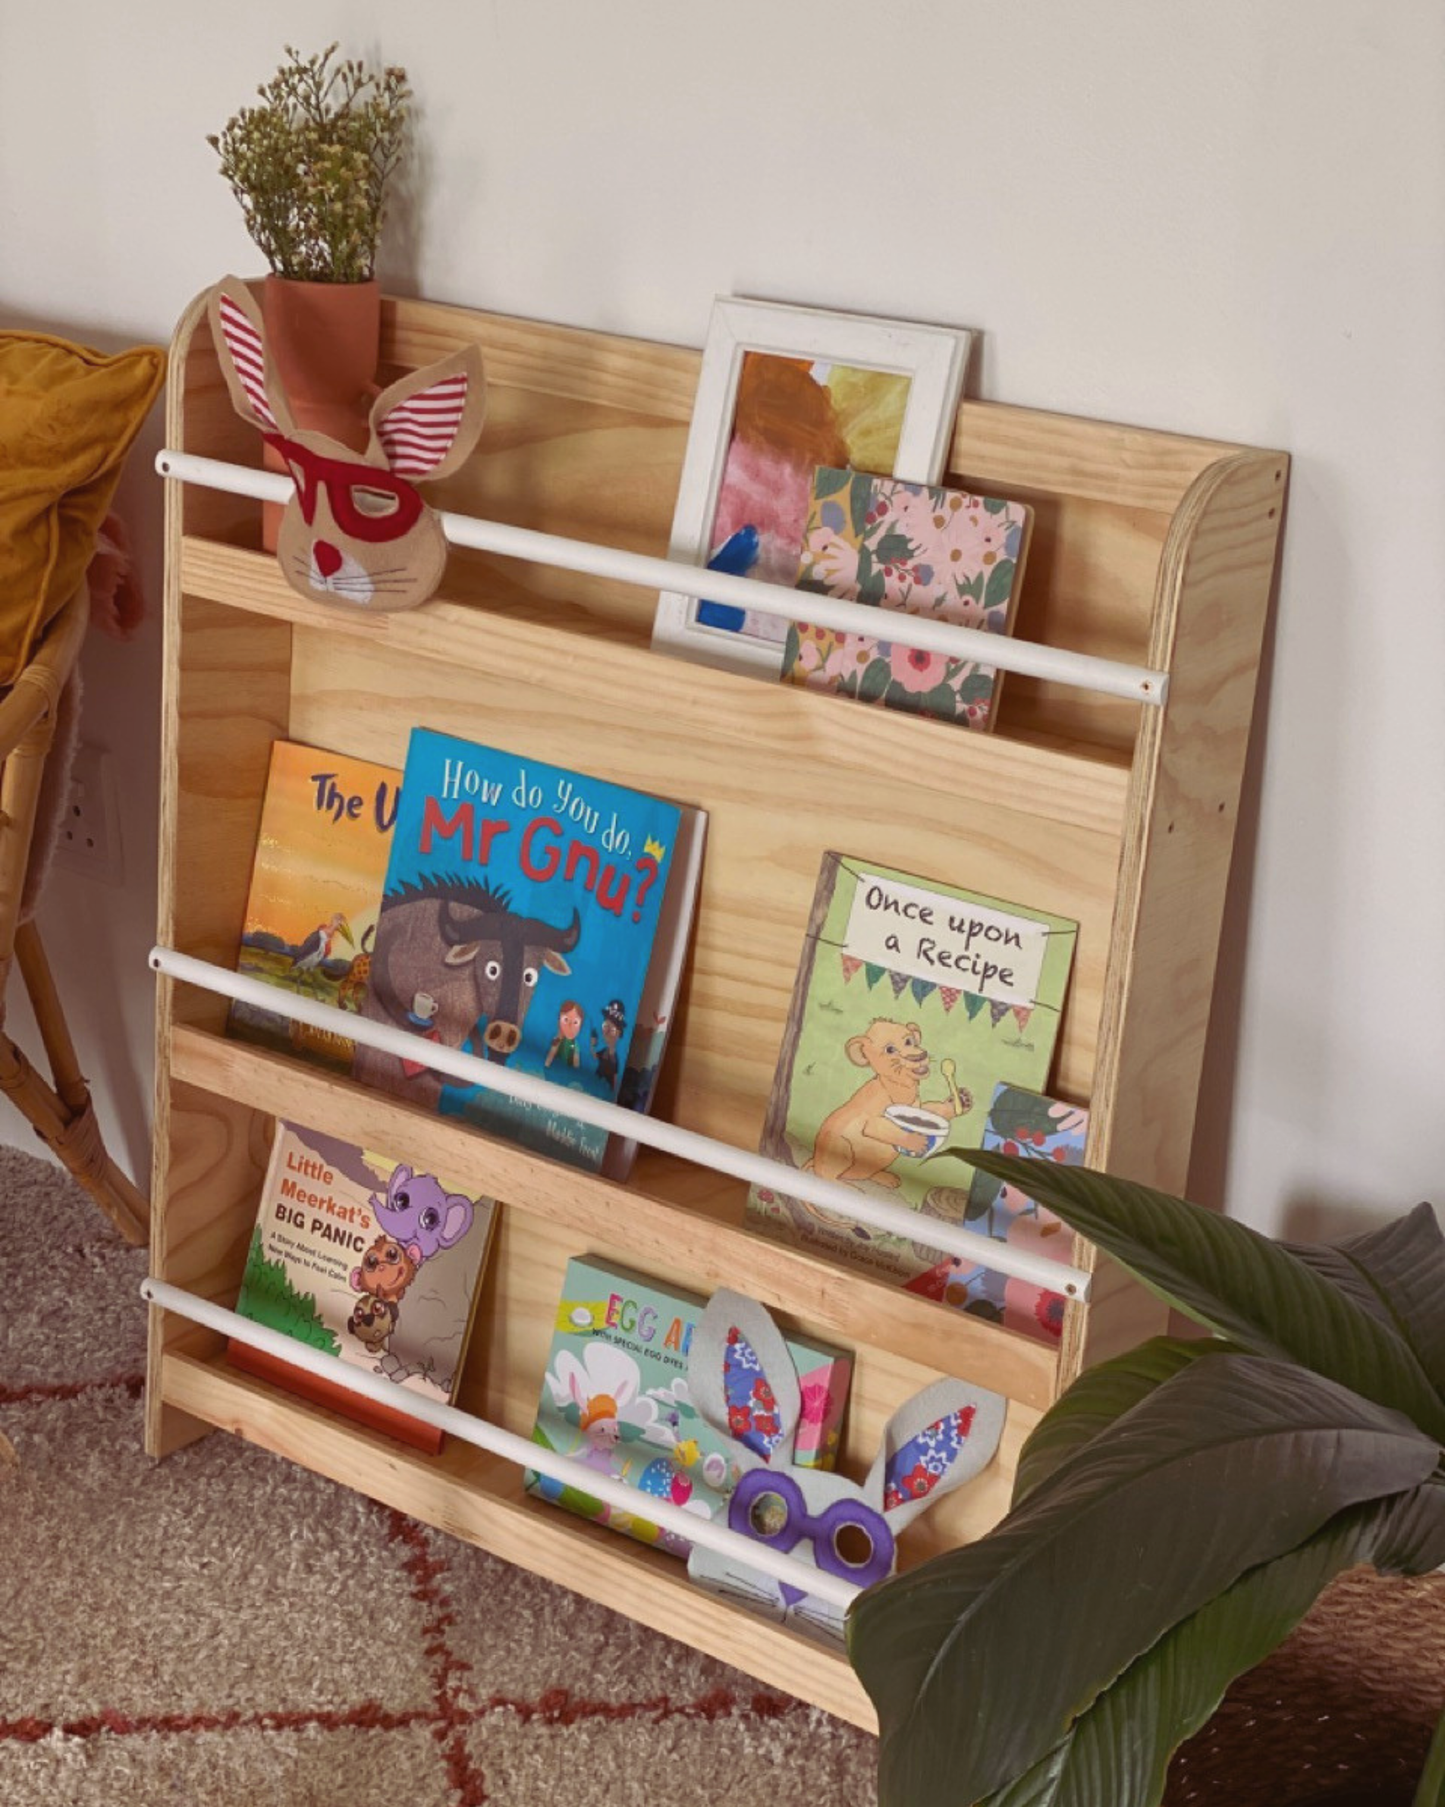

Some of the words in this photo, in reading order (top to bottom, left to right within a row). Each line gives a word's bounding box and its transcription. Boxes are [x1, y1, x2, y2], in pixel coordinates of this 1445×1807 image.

[310, 773, 363, 824] The
[441, 758, 503, 806] How
[511, 768, 542, 808] do
[601, 811, 632, 860] do,
[419, 795, 510, 866] Mr
[519, 816, 660, 923] Gnu?
[865, 885, 934, 926] Once
[948, 915, 1022, 951] upon
[884, 934, 901, 953] a
[917, 937, 1014, 994] Recipe
[286, 1151, 334, 1185] Little
[275, 1203, 305, 1230] BIG
[310, 1218, 366, 1253] PANIC
[281, 1178, 371, 1229] Meerkat's
[296, 1242, 316, 1257] About
[317, 1251, 349, 1272] Learning
[303, 1258, 311, 1268] to
[605, 1293, 659, 1343] EGG
[592, 1328, 612, 1342] WITH
[613, 1335, 643, 1354] SPECIAL
[643, 1348, 662, 1362] EGG
[663, 1355, 684, 1371] DYES
